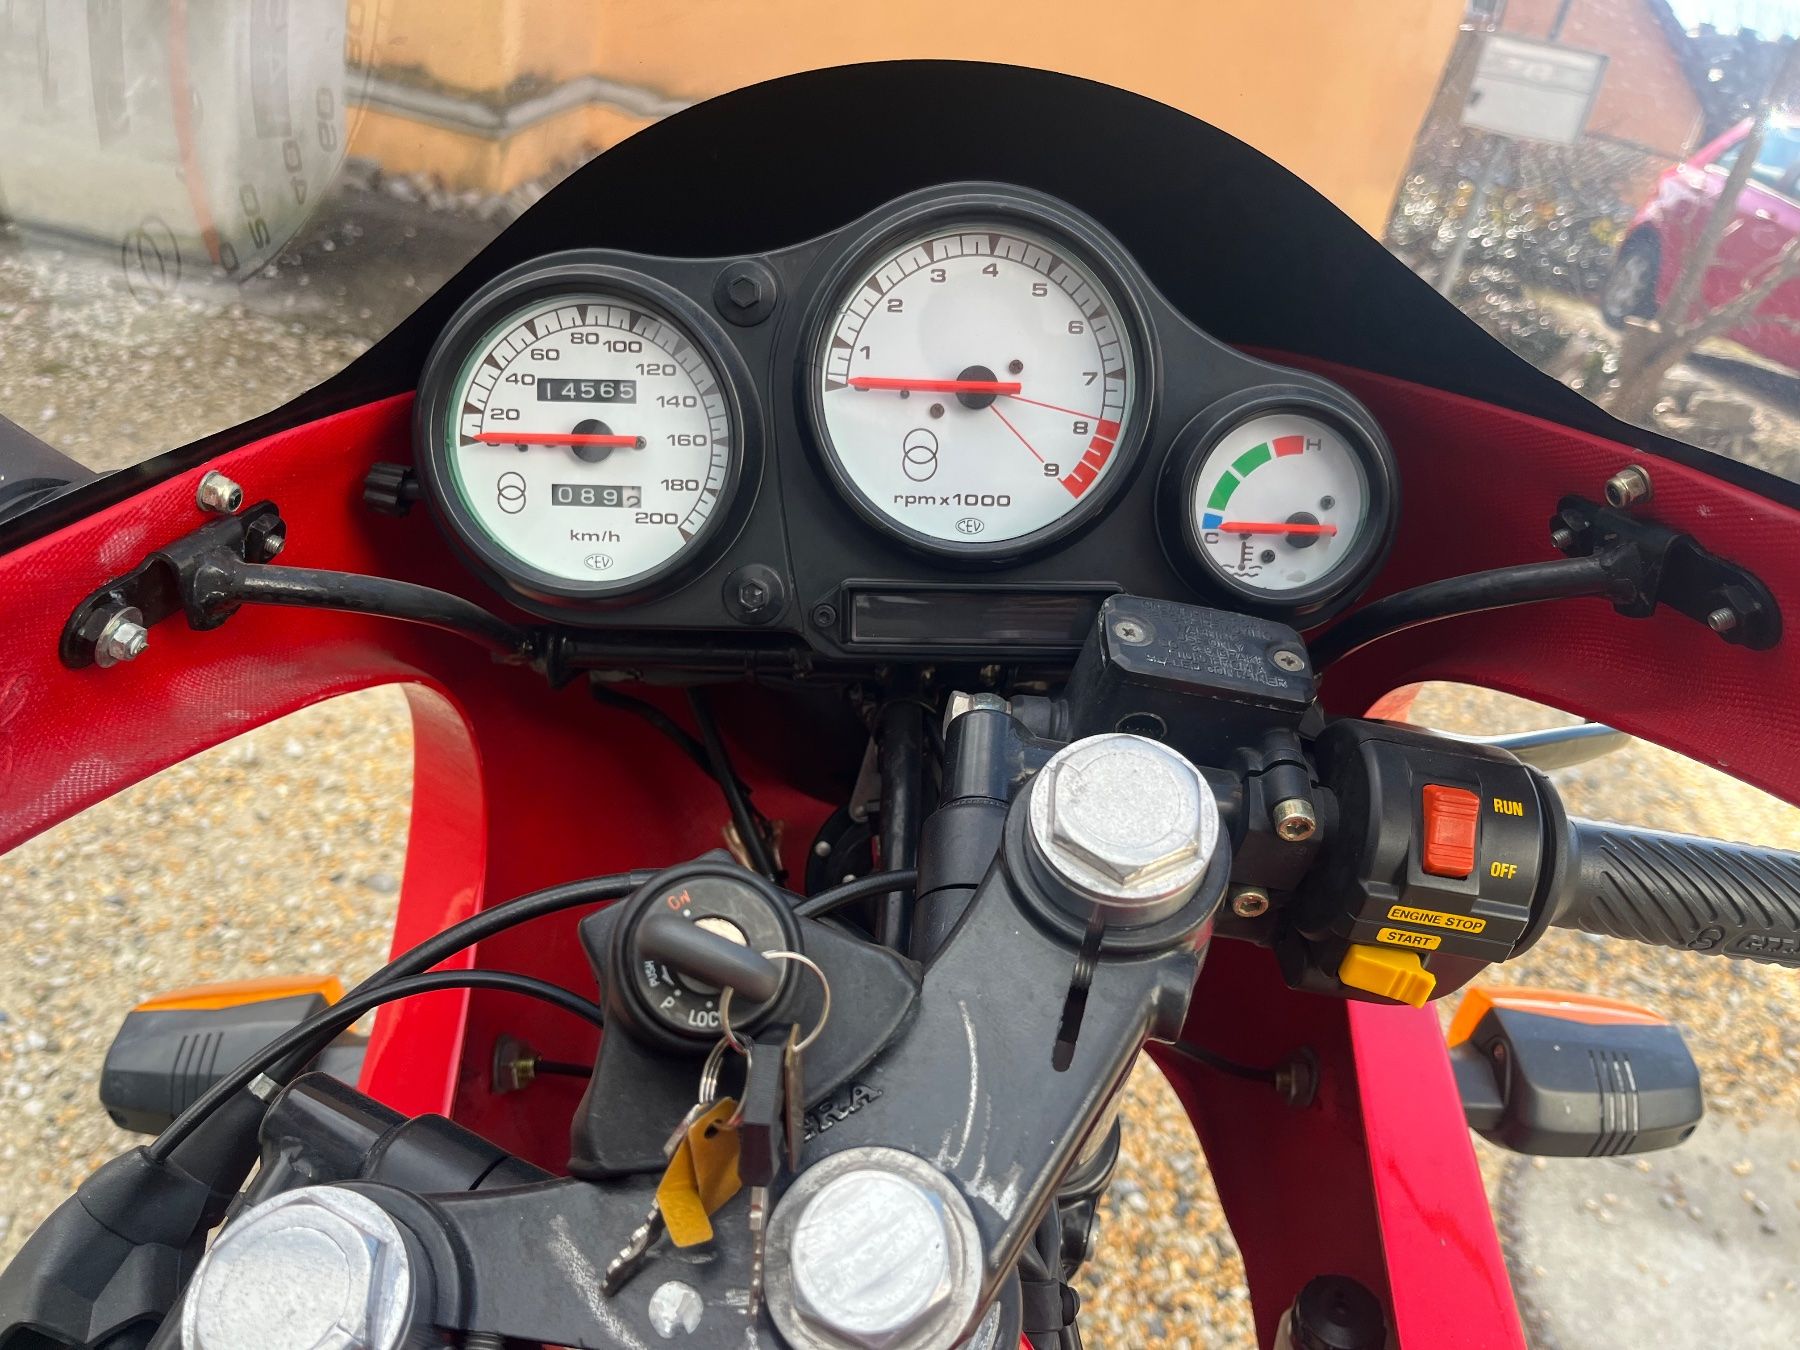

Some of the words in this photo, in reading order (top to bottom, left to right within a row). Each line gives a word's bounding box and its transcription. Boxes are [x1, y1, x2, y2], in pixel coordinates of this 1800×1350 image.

[929, 268, 947, 283] 3
[982, 262, 999, 278] 4
[1031, 282, 1048, 298] 5
[887, 298, 904, 314] 2
[1067, 320, 1084, 335] 6
[570, 332, 600, 346] 80
[602, 340, 643, 354] 100
[859, 345, 871, 360] 1
[530, 349, 560, 362] 60
[635, 363, 678, 377] 120
[504, 373, 537, 386] 40
[1082, 371, 1099, 387] 7
[546, 382, 634, 400] 14565
[656, 395, 698, 409] 140
[490, 408, 521, 421] 20
[1072, 420, 1089, 436] 8
[666, 434, 708, 448] 160
[1305, 438, 1323, 452] H
[1043, 462, 1061, 478] 9
[660, 479, 700, 492] 180
[634, 512, 679, 526] 200
[957, 518, 983, 534] CEV
[569, 529, 622, 544] km/h
[1203, 531, 1220, 545] C
[585, 555, 613, 570] CEV
[1493, 798, 1524, 817] RUN
[1490, 861, 1518, 880] OFF
[1391, 908, 1441, 926] ENGINE
[1444, 916, 1483, 931] STOP
[1386, 930, 1432, 947] START
[660, 996, 676, 1010] P
[688, 1009, 722, 1027] LOC
